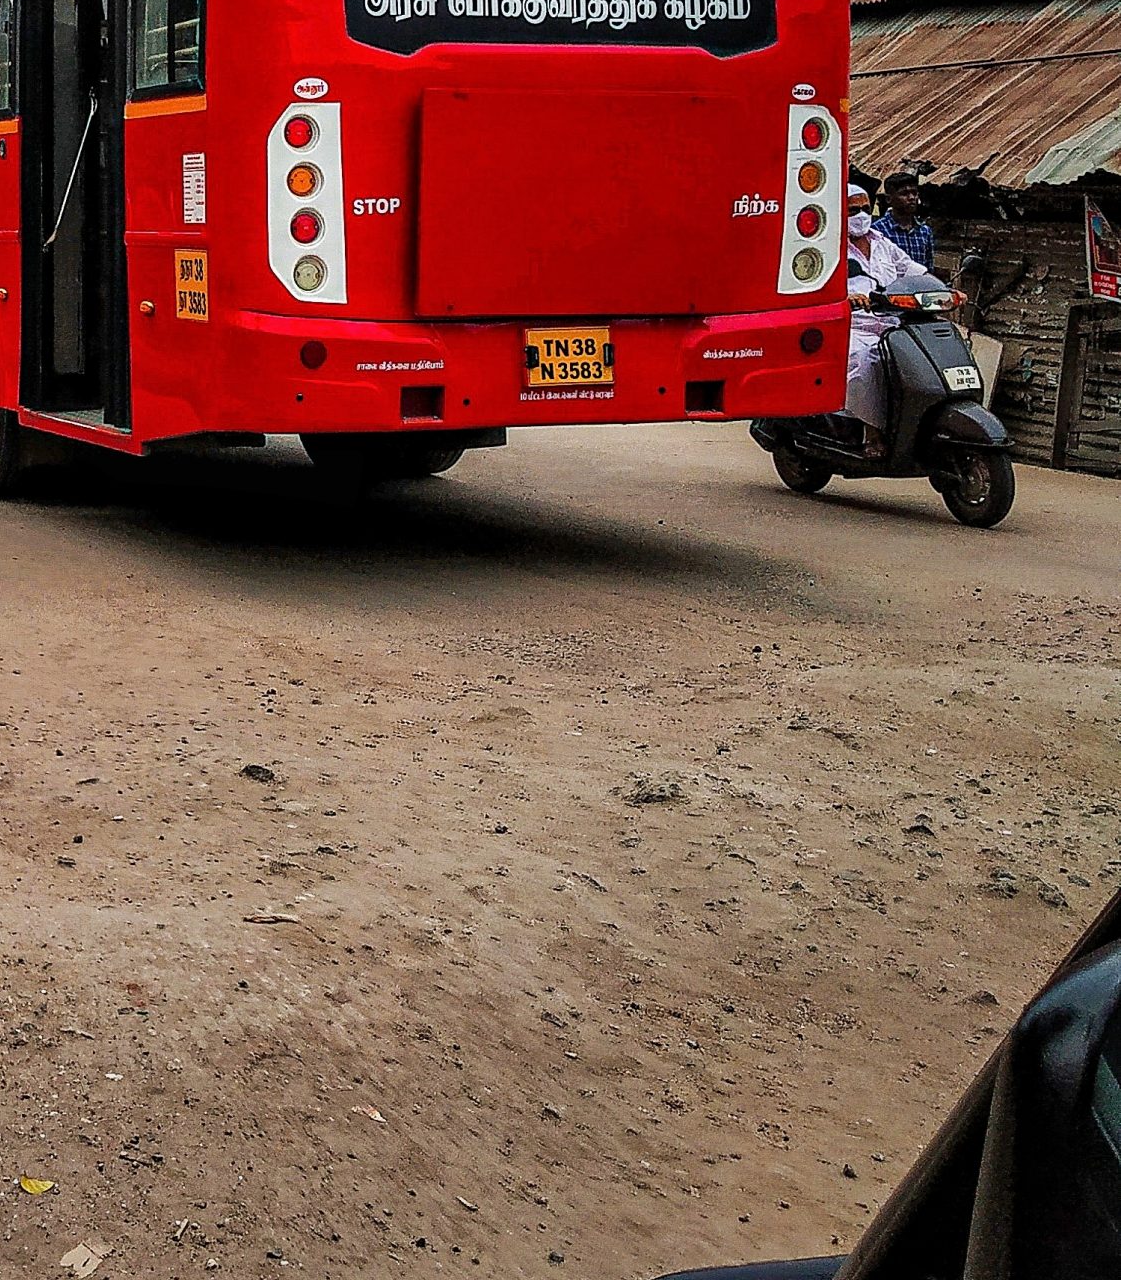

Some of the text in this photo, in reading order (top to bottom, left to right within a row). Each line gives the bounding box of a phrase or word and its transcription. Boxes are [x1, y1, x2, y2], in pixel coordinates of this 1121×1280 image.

[353, 197, 401, 216] STOP
[731, 192, 780, 219] நிற்க
[188, 290, 207, 316] 3583
[543, 338, 597, 357] TN 38
[540, 361, 603, 380] N 3583
[520, 392, 528, 401] 10
